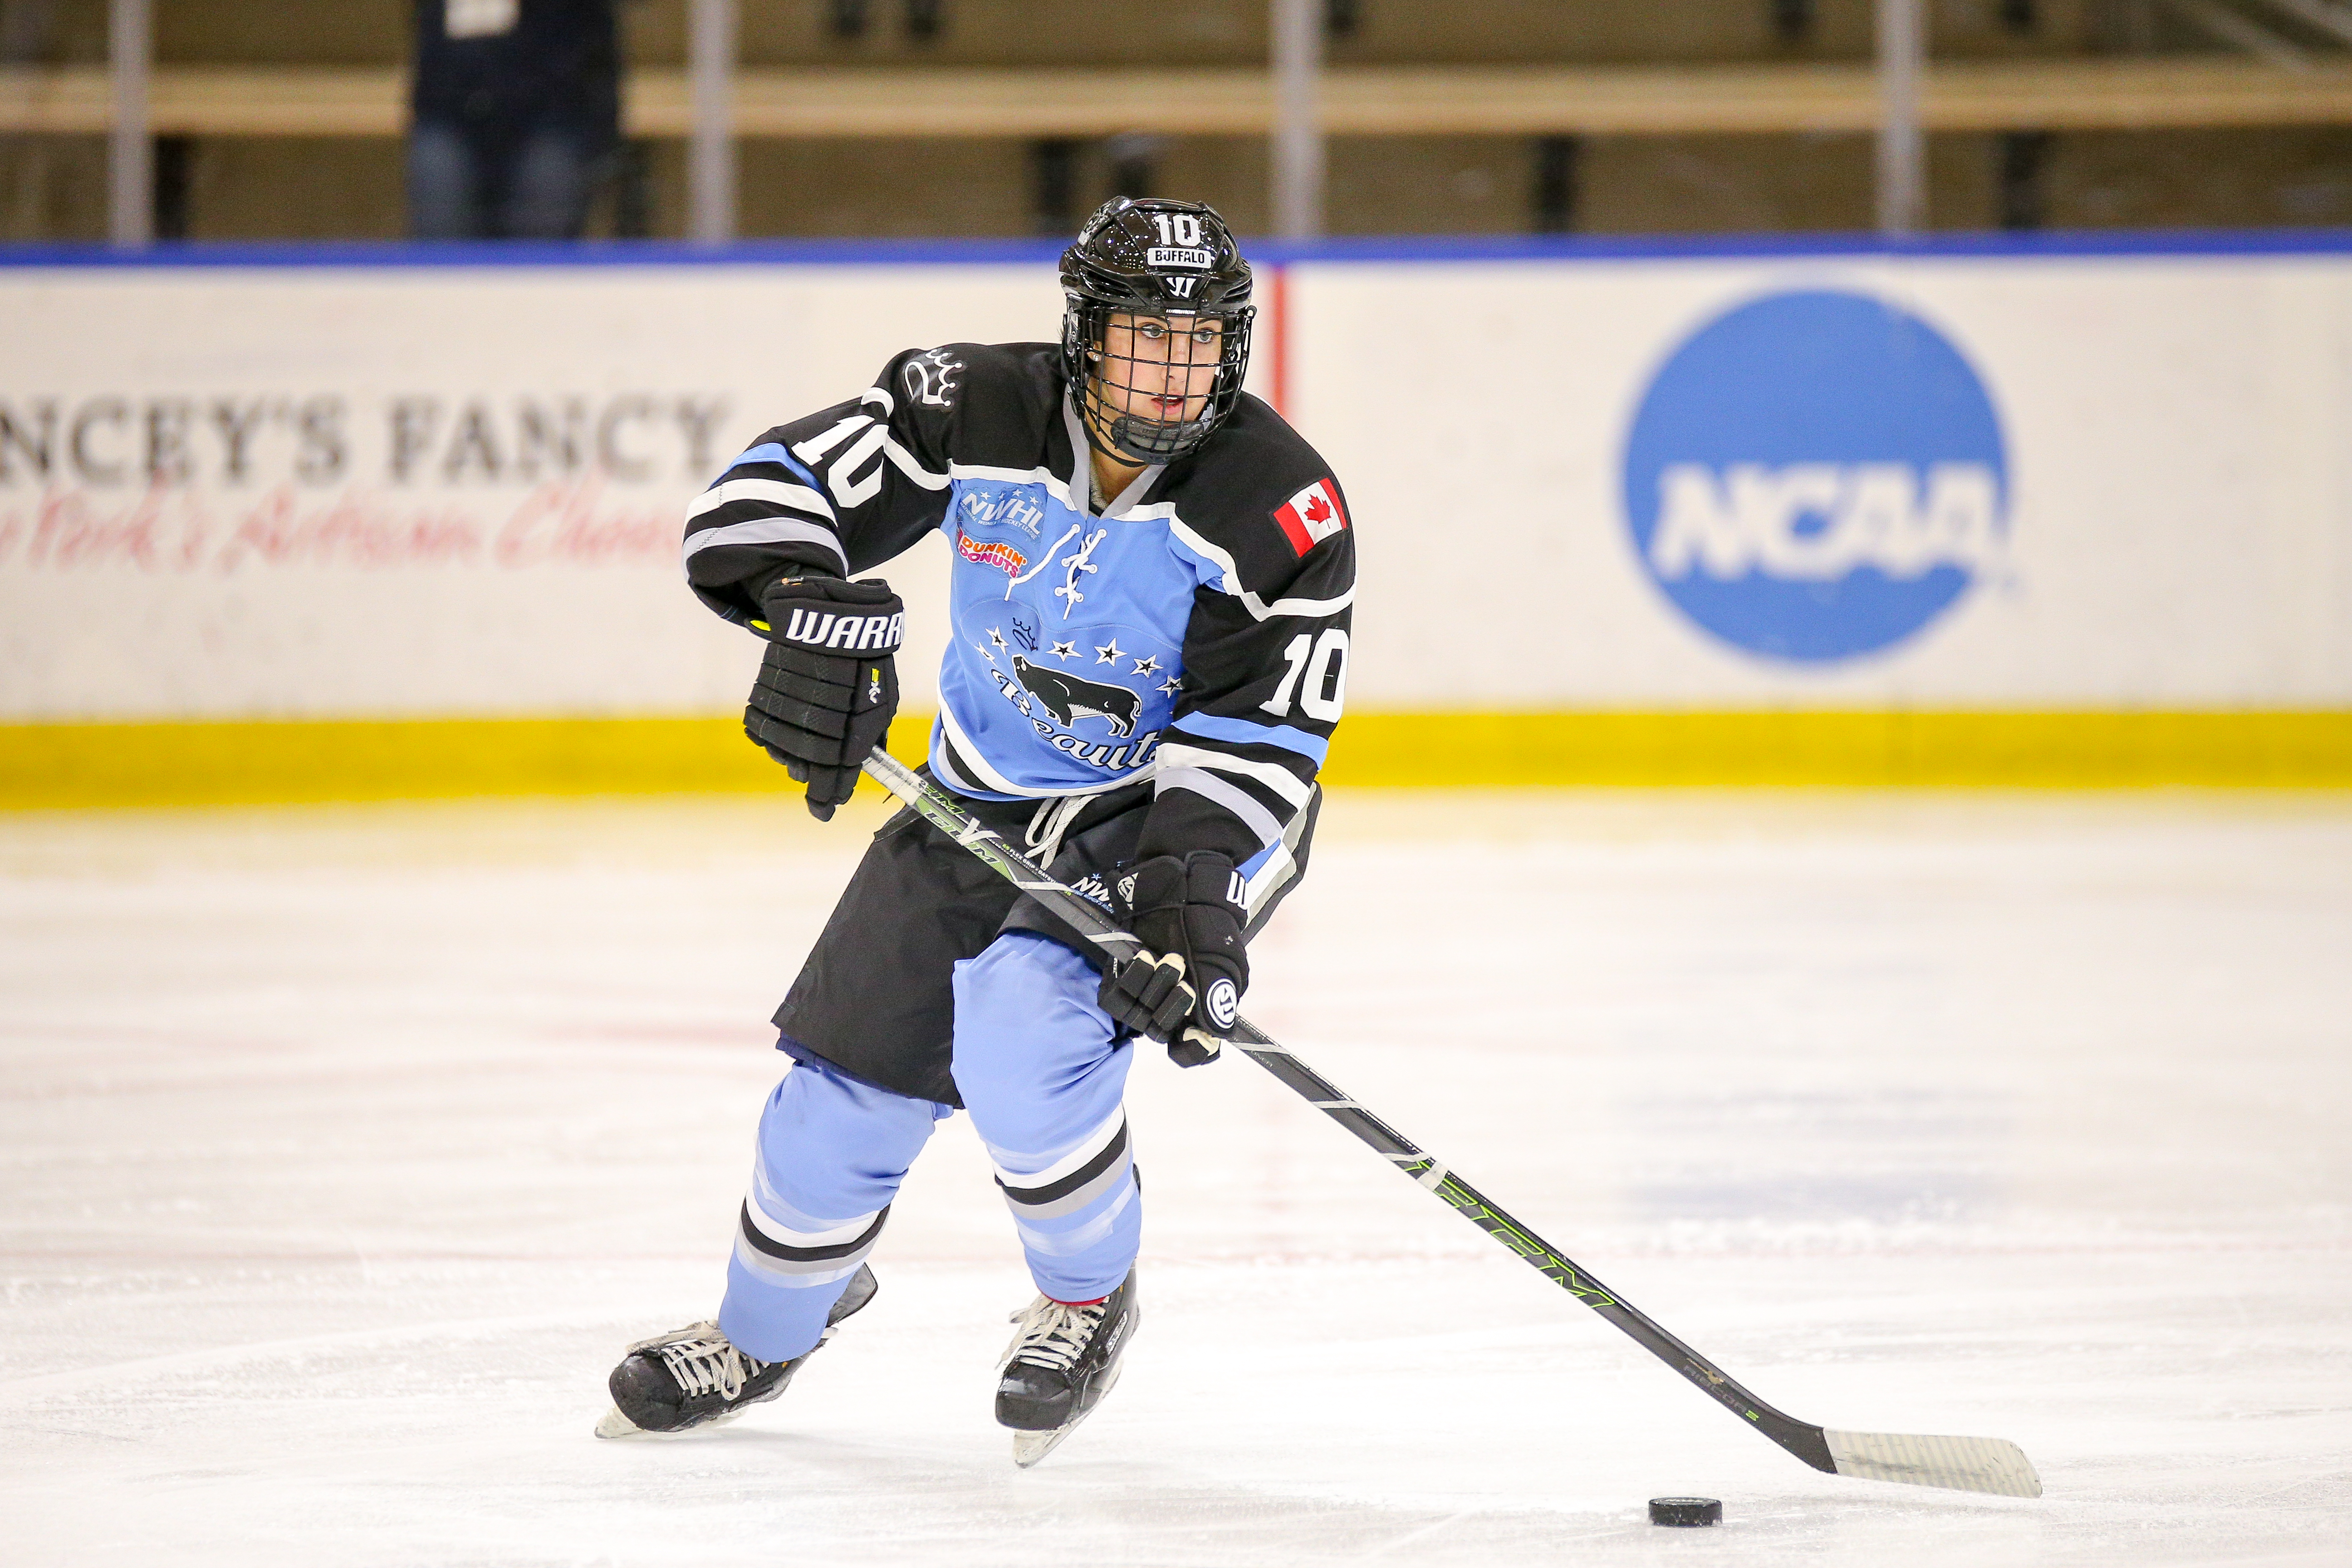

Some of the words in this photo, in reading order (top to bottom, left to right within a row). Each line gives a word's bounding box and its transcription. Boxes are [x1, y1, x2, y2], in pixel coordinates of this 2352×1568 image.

[1153, 214, 1201, 246] 10
[1155, 250, 1205, 264] BUFFALO
[387, 392, 733, 484] FANCY
[791, 414, 889, 508] 10
[962, 493, 1044, 535] NWHL
[1649, 463, 2009, 581] NCAA
[959, 544, 1019, 578] DONUTS
[961, 536, 1027, 567] DUNKIN'
[1259, 628, 1349, 723] 10
[1070, 877, 1112, 908] NW
